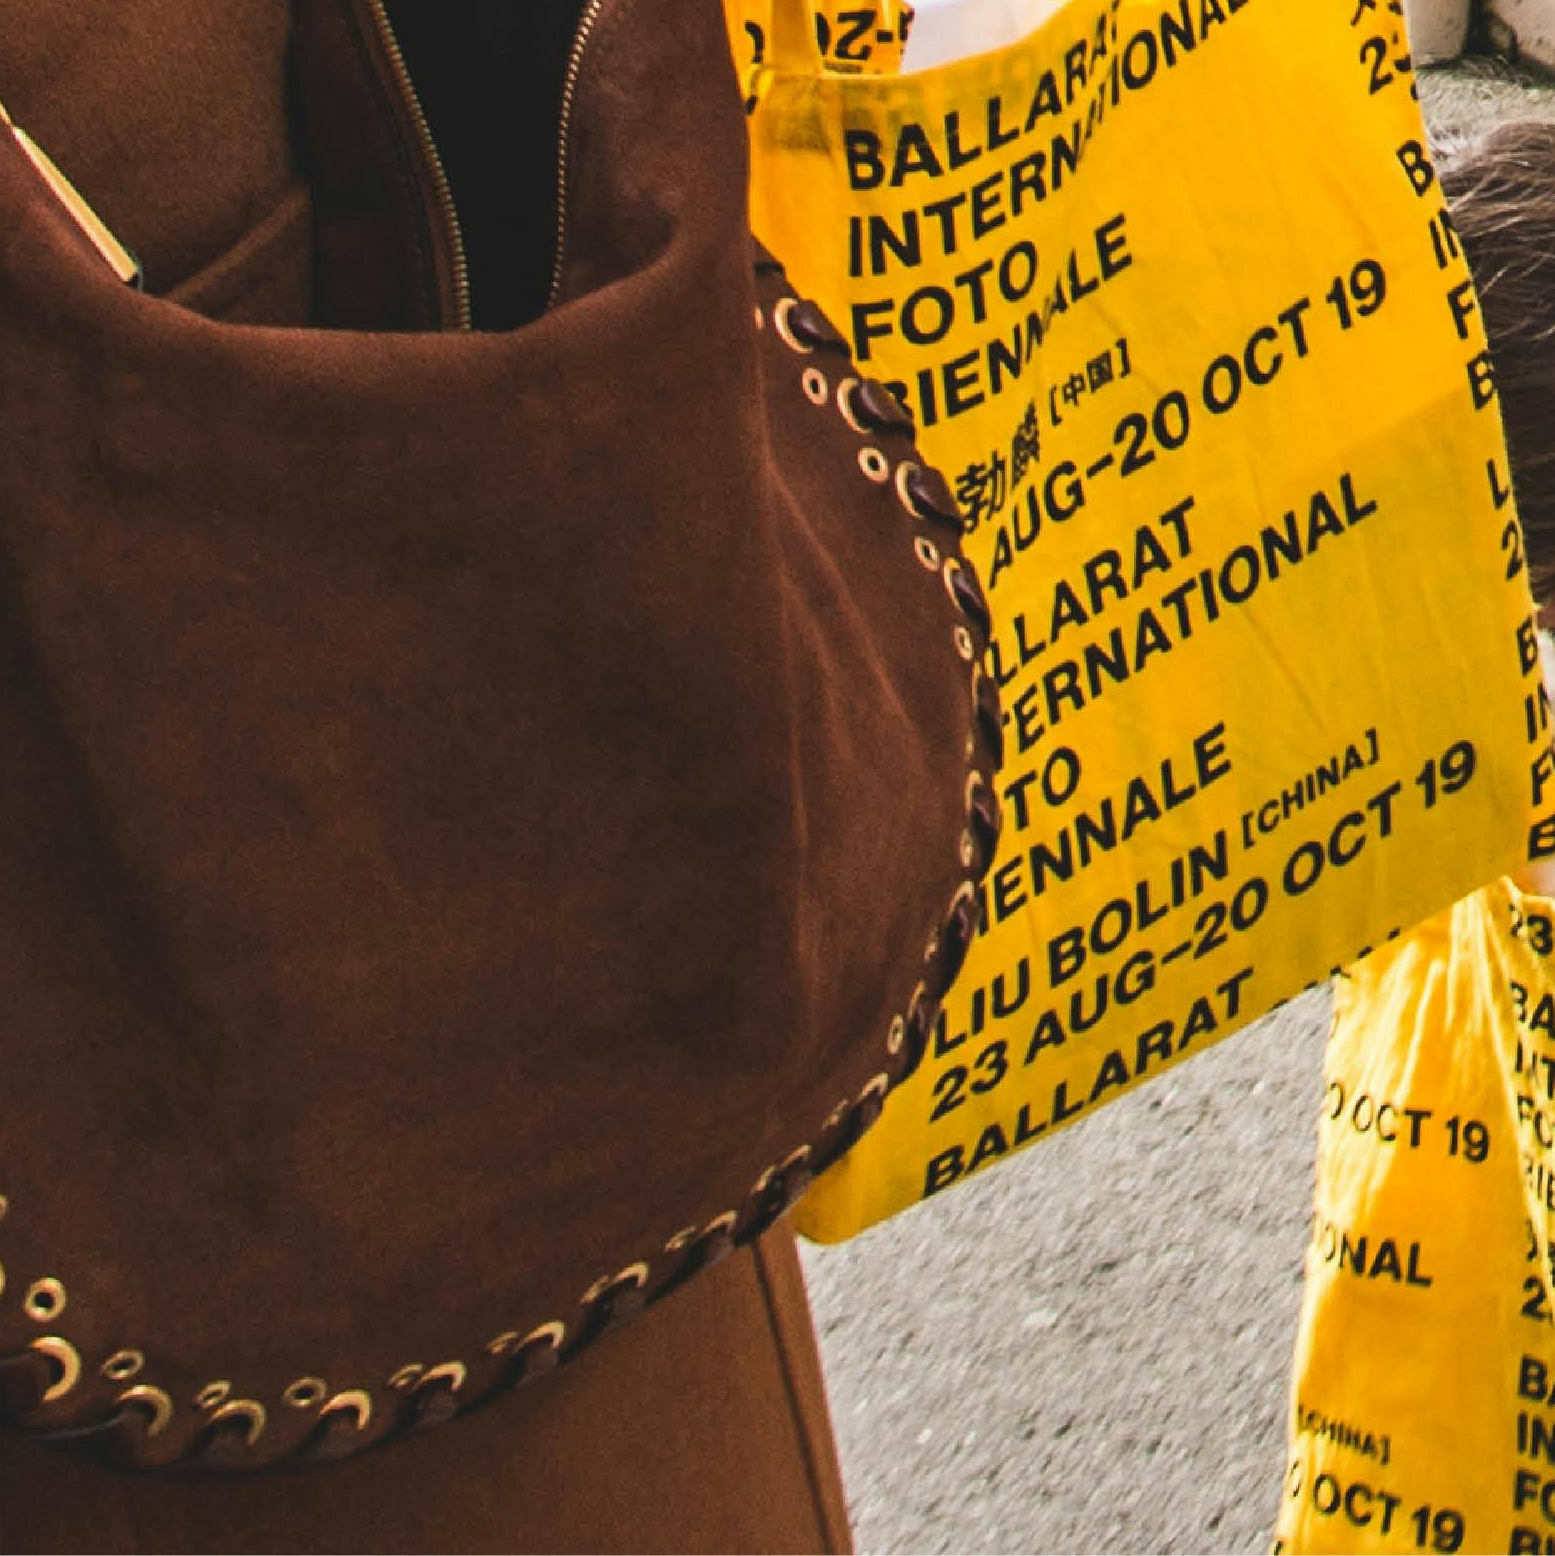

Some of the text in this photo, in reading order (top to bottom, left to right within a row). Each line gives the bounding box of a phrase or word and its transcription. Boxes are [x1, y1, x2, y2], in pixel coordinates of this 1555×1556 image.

[851, 240, 1038, 361] FOTO
[1201, 297, 1311, 415] OCT
[1324, 259, 1387, 330] 19
[1000, 472, 1378, 755] ERNATIONAL
[1003, 744, 1082, 832] TO
[930, 1040, 1009, 1123] 23
[1282, 781, 1402, 897] OCT
[1414, 739, 1478, 808] 19
[932, 958, 1032, 1060] LIU
[1047, 831, 1229, 989] BOLIN
[1241, 728, 1380, 850] [CHINA]
[922, 967, 1255, 1200] BALLARAT
[1352, 1094, 1434, 1149] OCT
[1445, 1114, 1490, 1164] 19
[1312, 1471, 1403, 1538] OCT
[1410, 1503, 1466, 1556] 19
